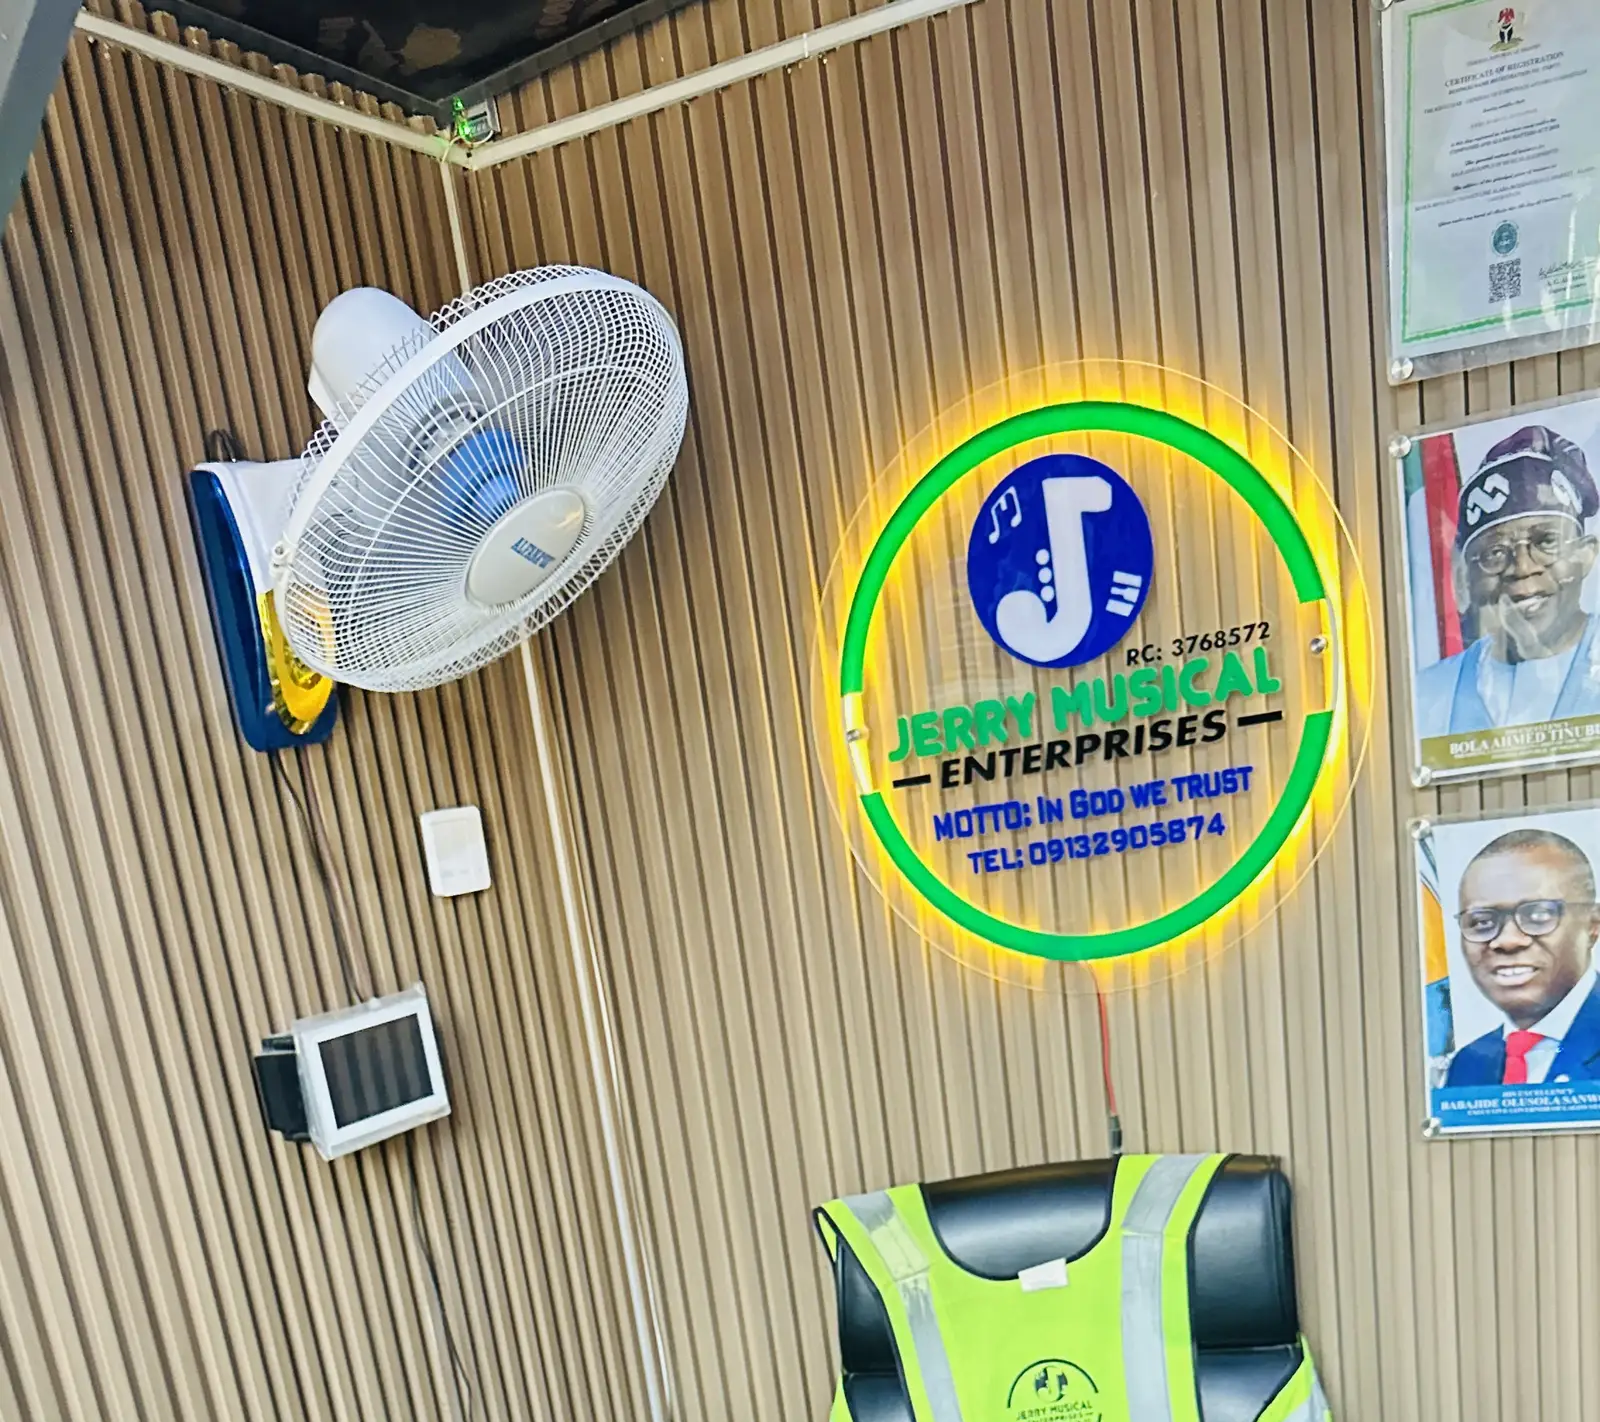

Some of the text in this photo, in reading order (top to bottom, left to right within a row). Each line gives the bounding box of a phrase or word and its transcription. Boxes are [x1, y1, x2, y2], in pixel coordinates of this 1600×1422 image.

[1126, 621, 1271, 667] RC: 3768572
[888, 645, 1281, 763] JERRY MUSICAL
[941, 709, 1228, 789] ENTERPRISES
[1450, 738, 1489, 755] BOLA
[1491, 729, 1546, 749] AHMED
[933, 801, 1032, 842] MOTTO:
[1171, 765, 1254, 798] TRUST
[967, 812, 1226, 874] TEL: 09132905874
[1441, 1098, 1499, 1111] BABAJIDE
[1502, 1095, 1560, 1107] OLUSOLA
[1016, 1400, 1093, 1421] JERRY MUSICAL
